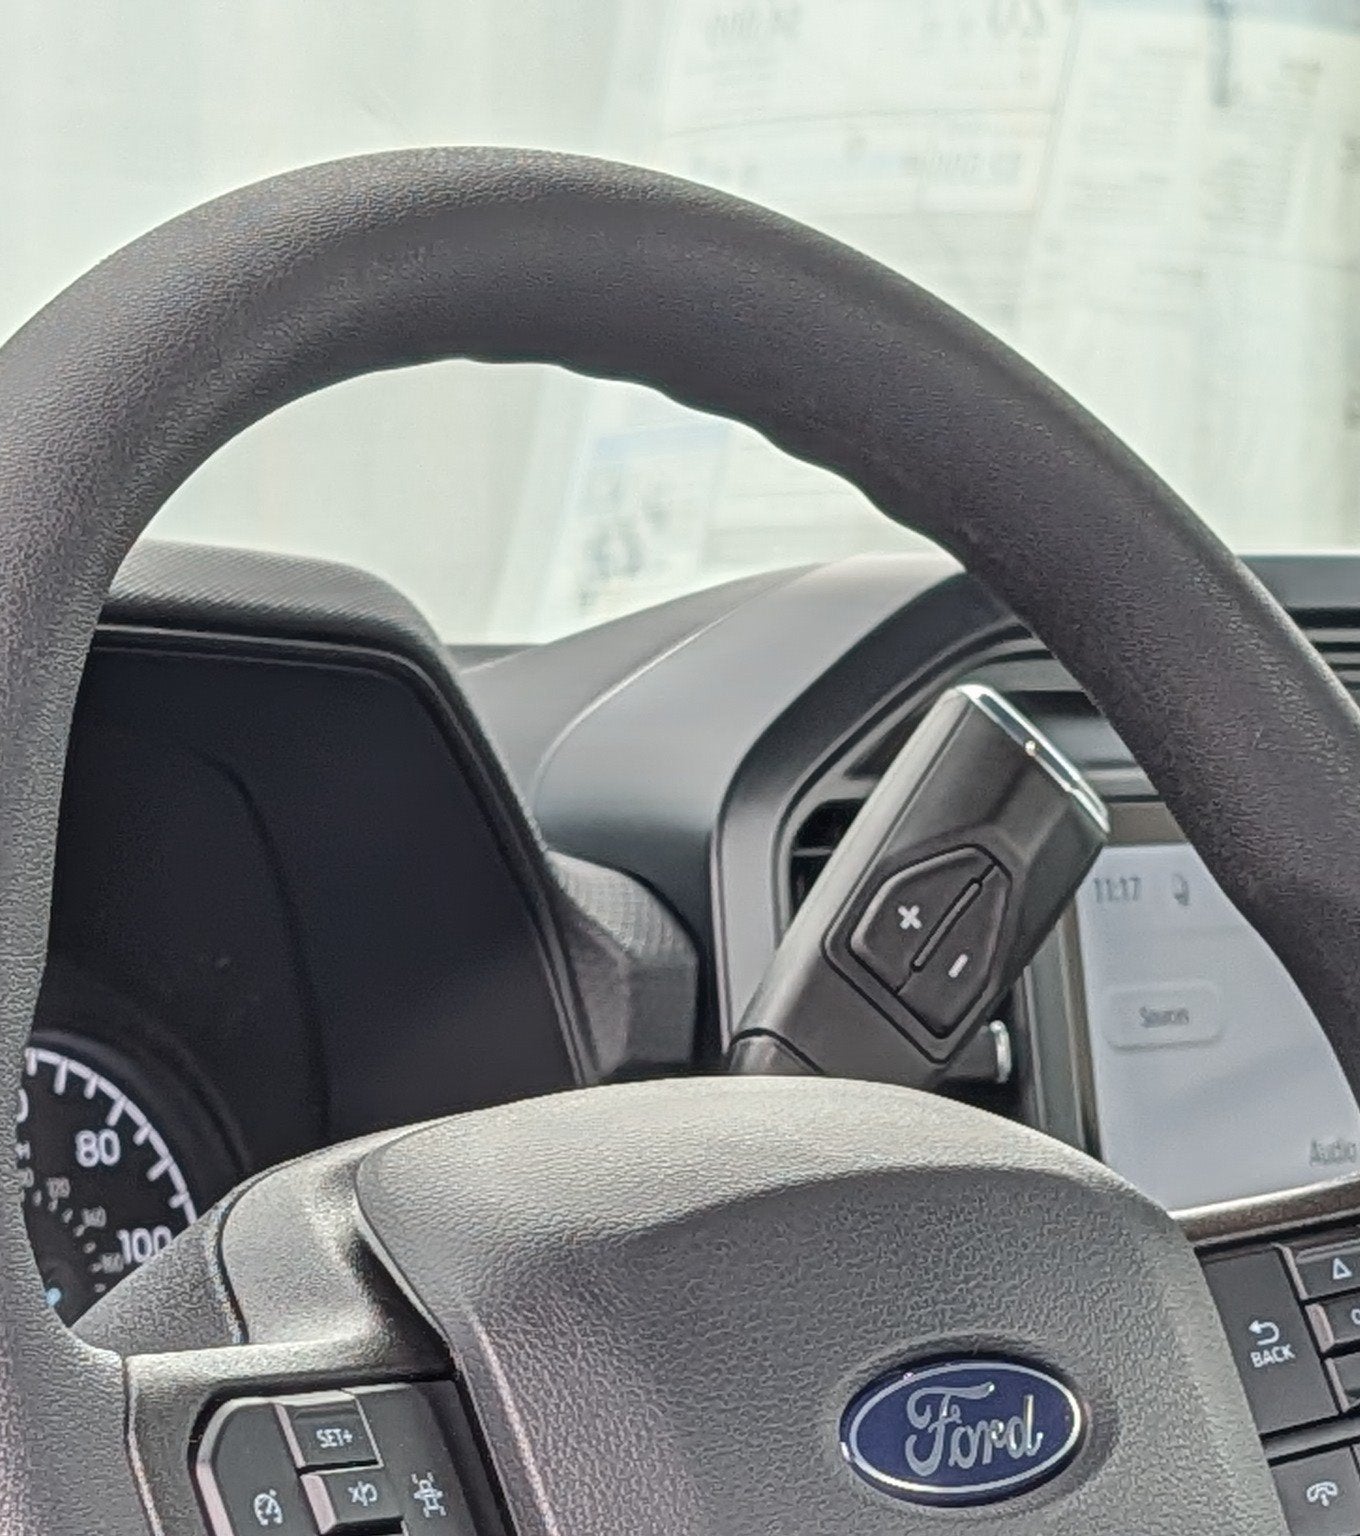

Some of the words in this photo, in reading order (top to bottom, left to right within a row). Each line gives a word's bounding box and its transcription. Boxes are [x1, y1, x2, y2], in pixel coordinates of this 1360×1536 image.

[74, 1129, 121, 1168] 80
[1250, 1344, 1295, 1368] BACK
[905, 1381, 1043, 1477] Ford
